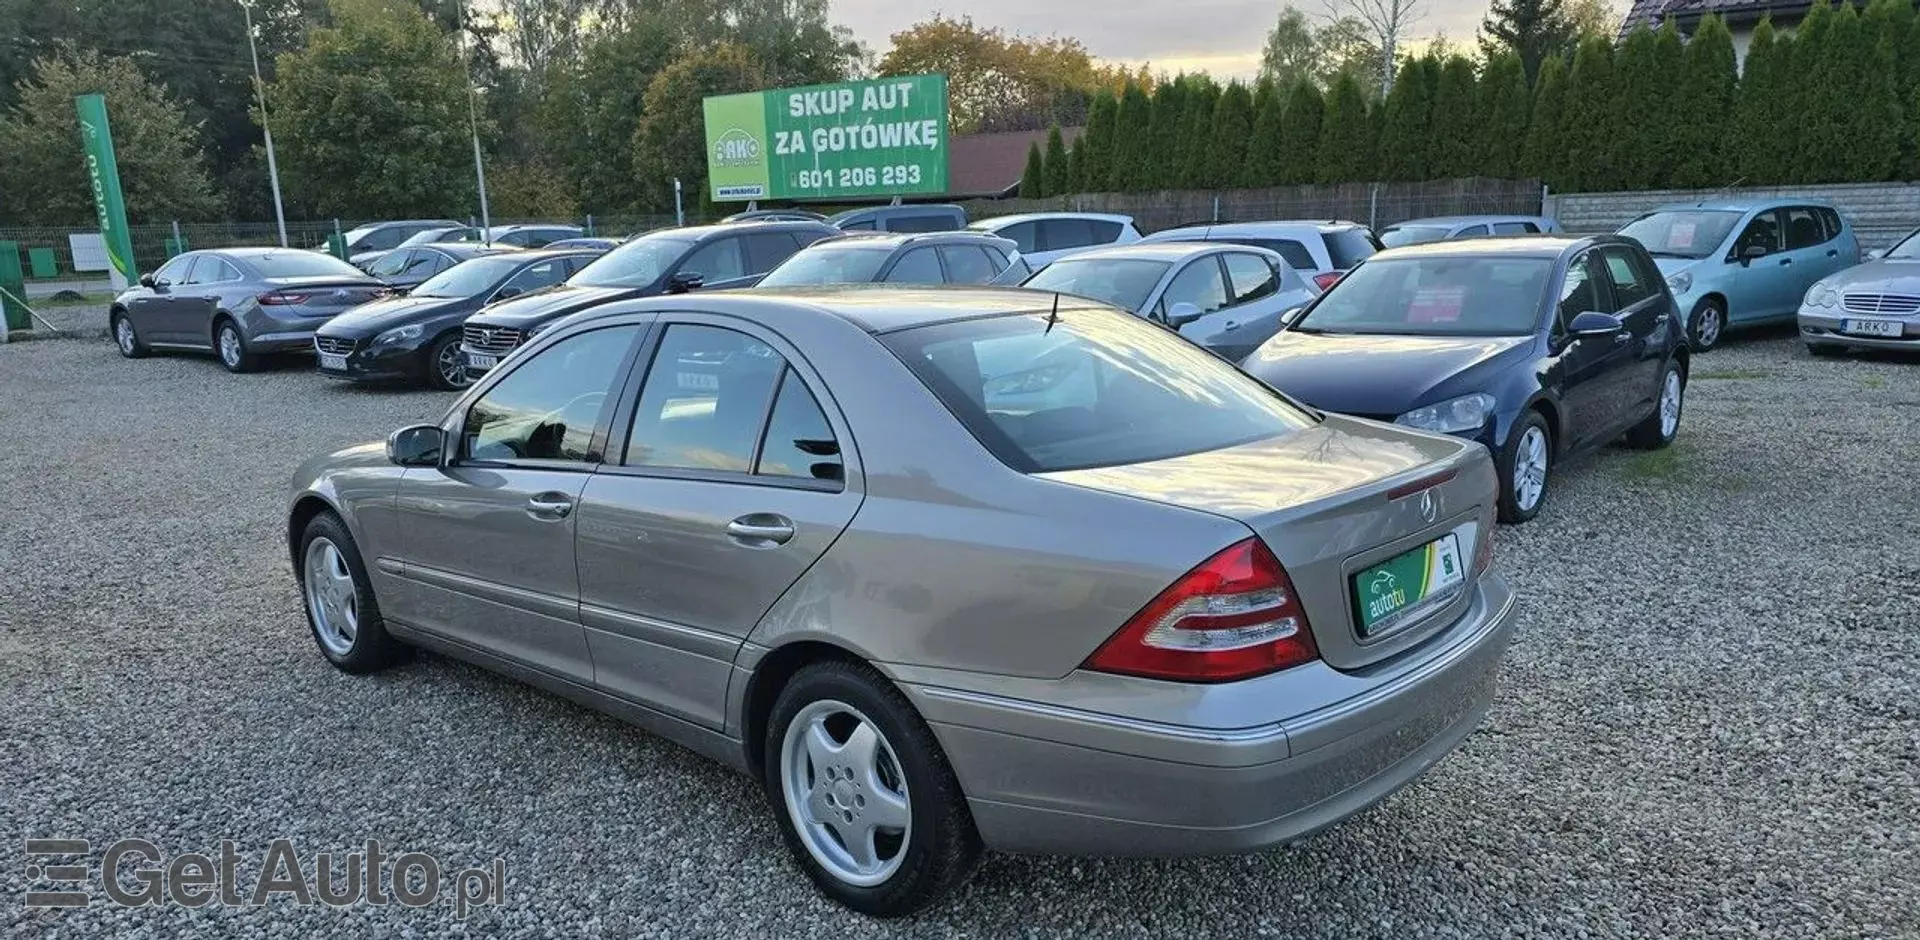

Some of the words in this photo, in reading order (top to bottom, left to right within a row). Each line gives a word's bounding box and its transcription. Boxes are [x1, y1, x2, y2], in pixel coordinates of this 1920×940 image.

[789, 90, 854, 117] SKUP
[861, 83, 912, 112] AUT
[775, 131, 806, 155] ZA
[812, 117, 938, 151] GOTÓWKĘ
[88, 154, 110, 230] autotu
[799, 169, 834, 188] 601
[839, 167, 877, 187] 206
[882, 165, 921, 185] 293
[1856, 322, 1889, 332] ARKO
[1369, 588, 1406, 618] autotu
